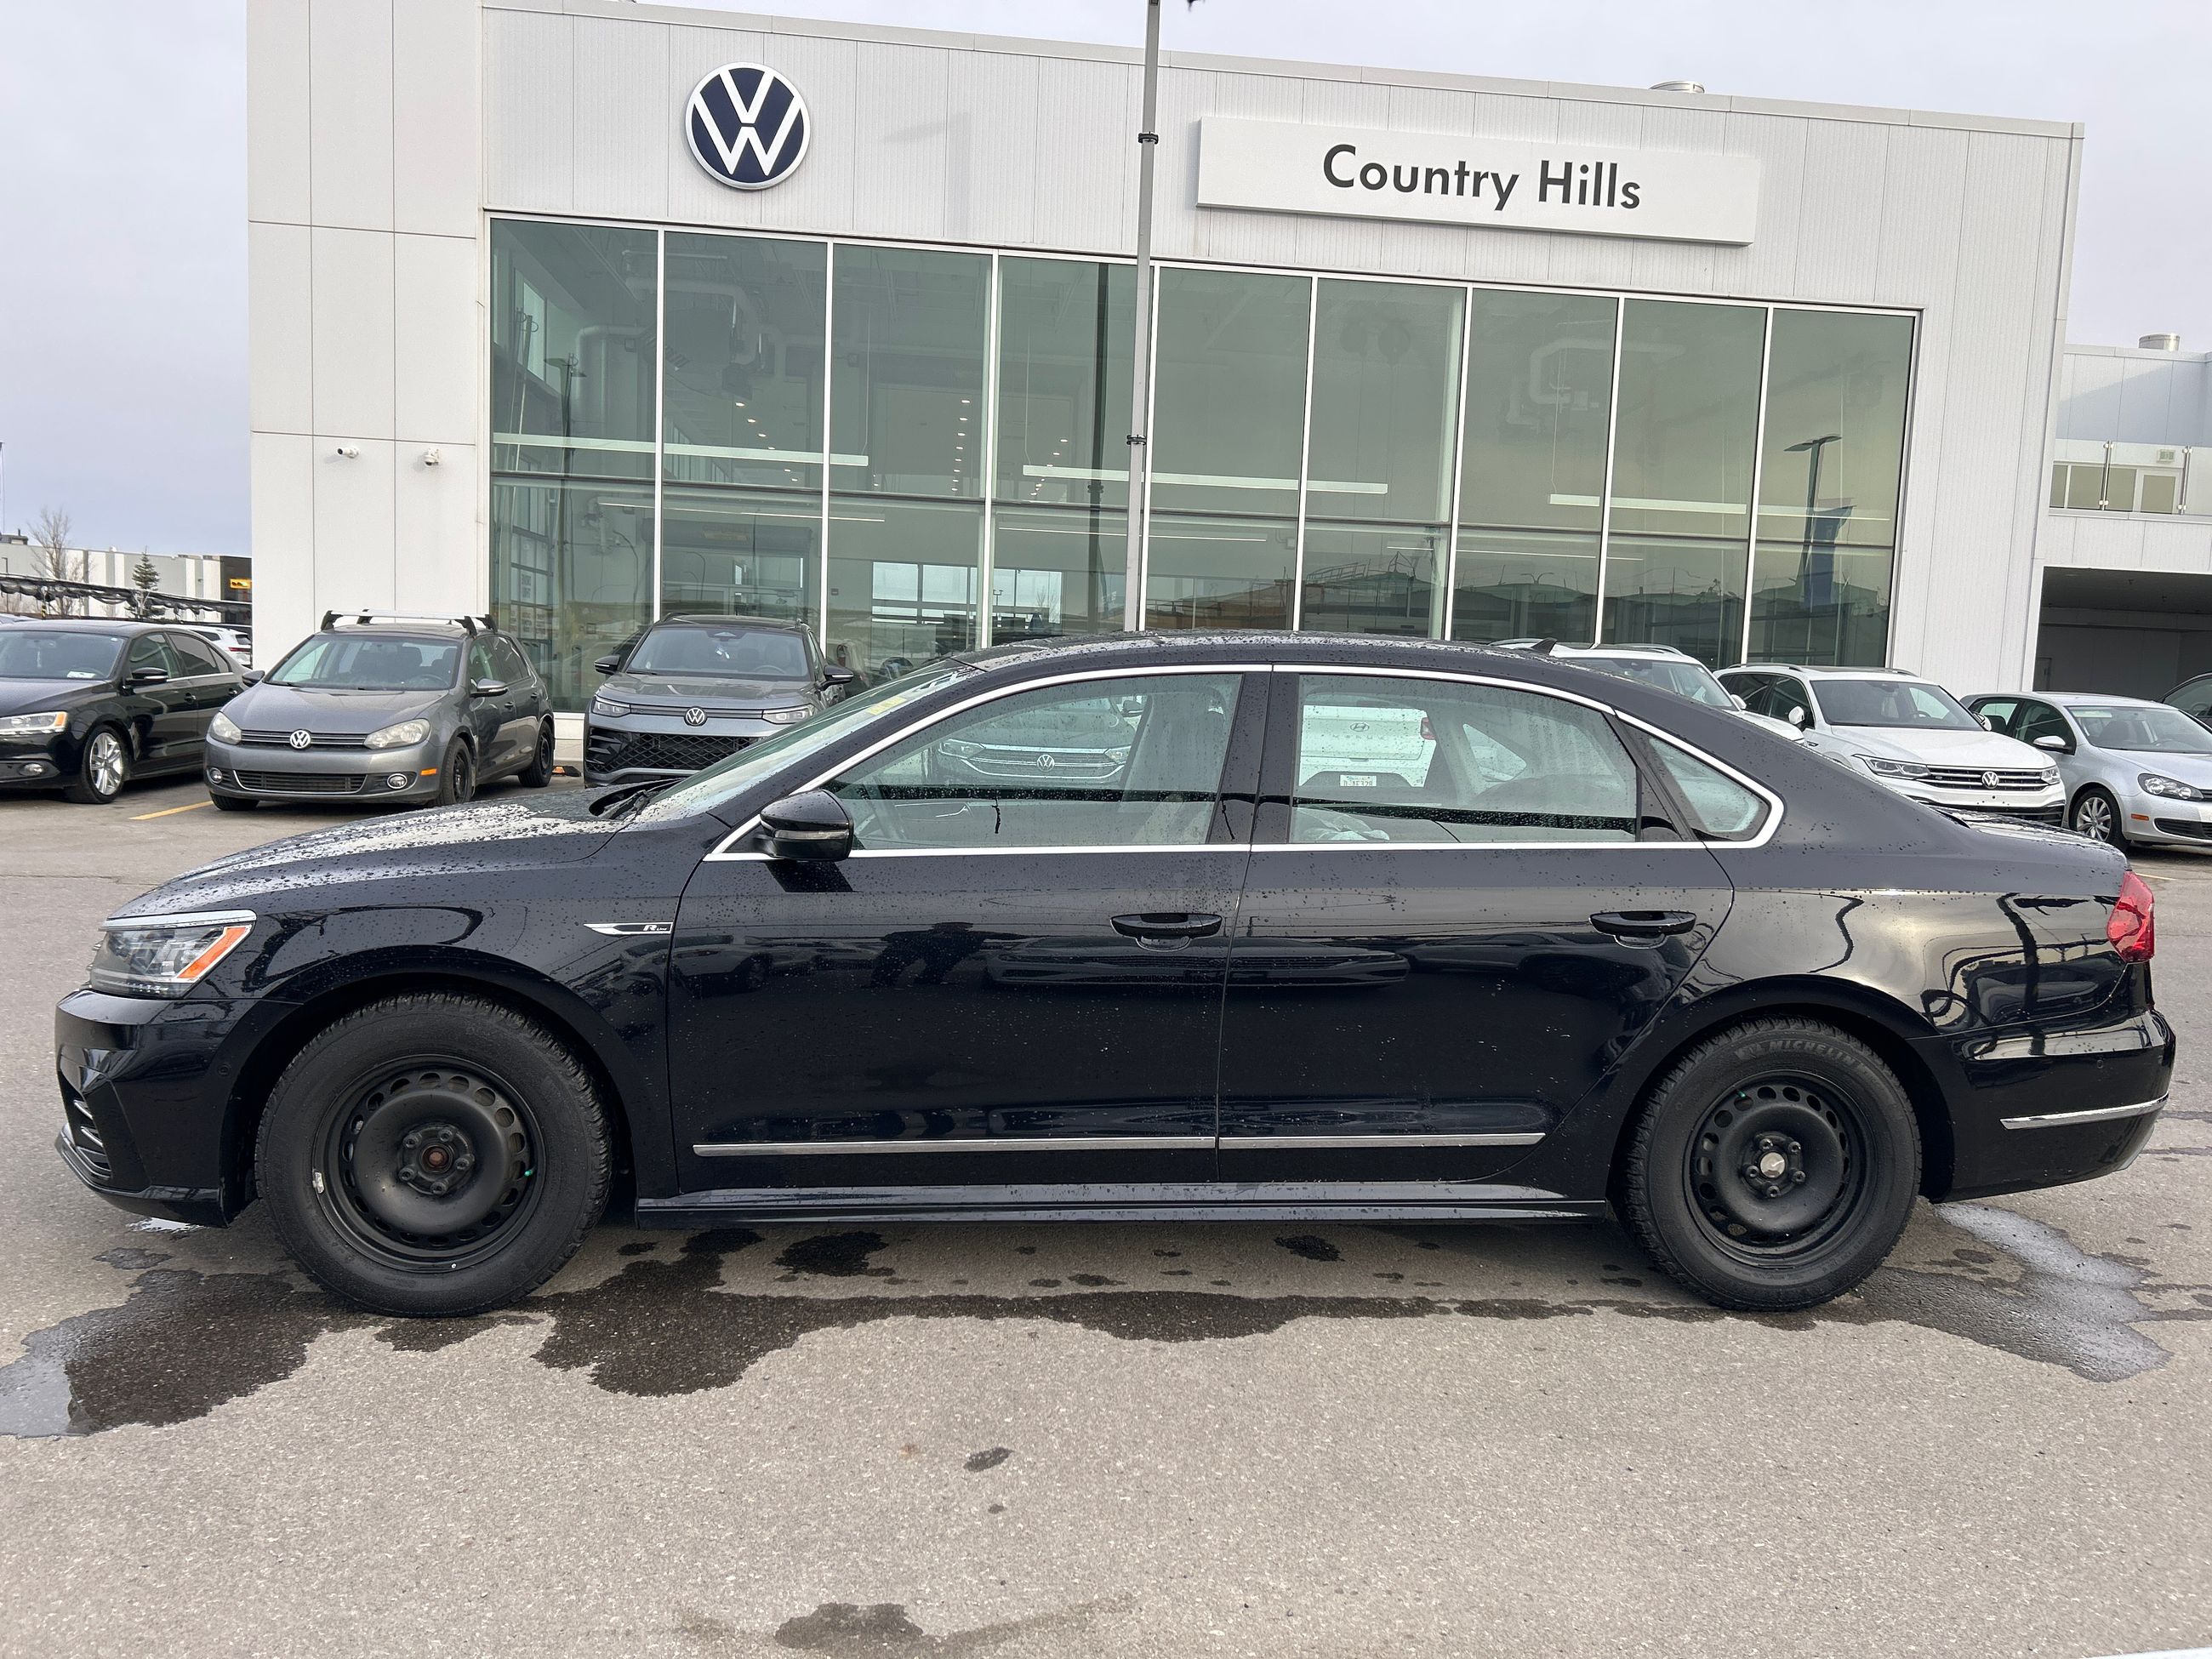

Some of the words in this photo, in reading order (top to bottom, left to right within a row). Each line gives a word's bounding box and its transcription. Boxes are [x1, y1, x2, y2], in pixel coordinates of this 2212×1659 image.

[686, 62, 810, 190] VW
[1323, 144, 1519, 211] Country
[1539, 160, 1640, 208] Hills
[686, 708, 705, 726] VW
[289, 730, 311, 749] VW
[1037, 755, 1055, 772] VW
[1982, 772, 1999, 790] VW
[1769, 1040, 1856, 1064] MICHELIN
